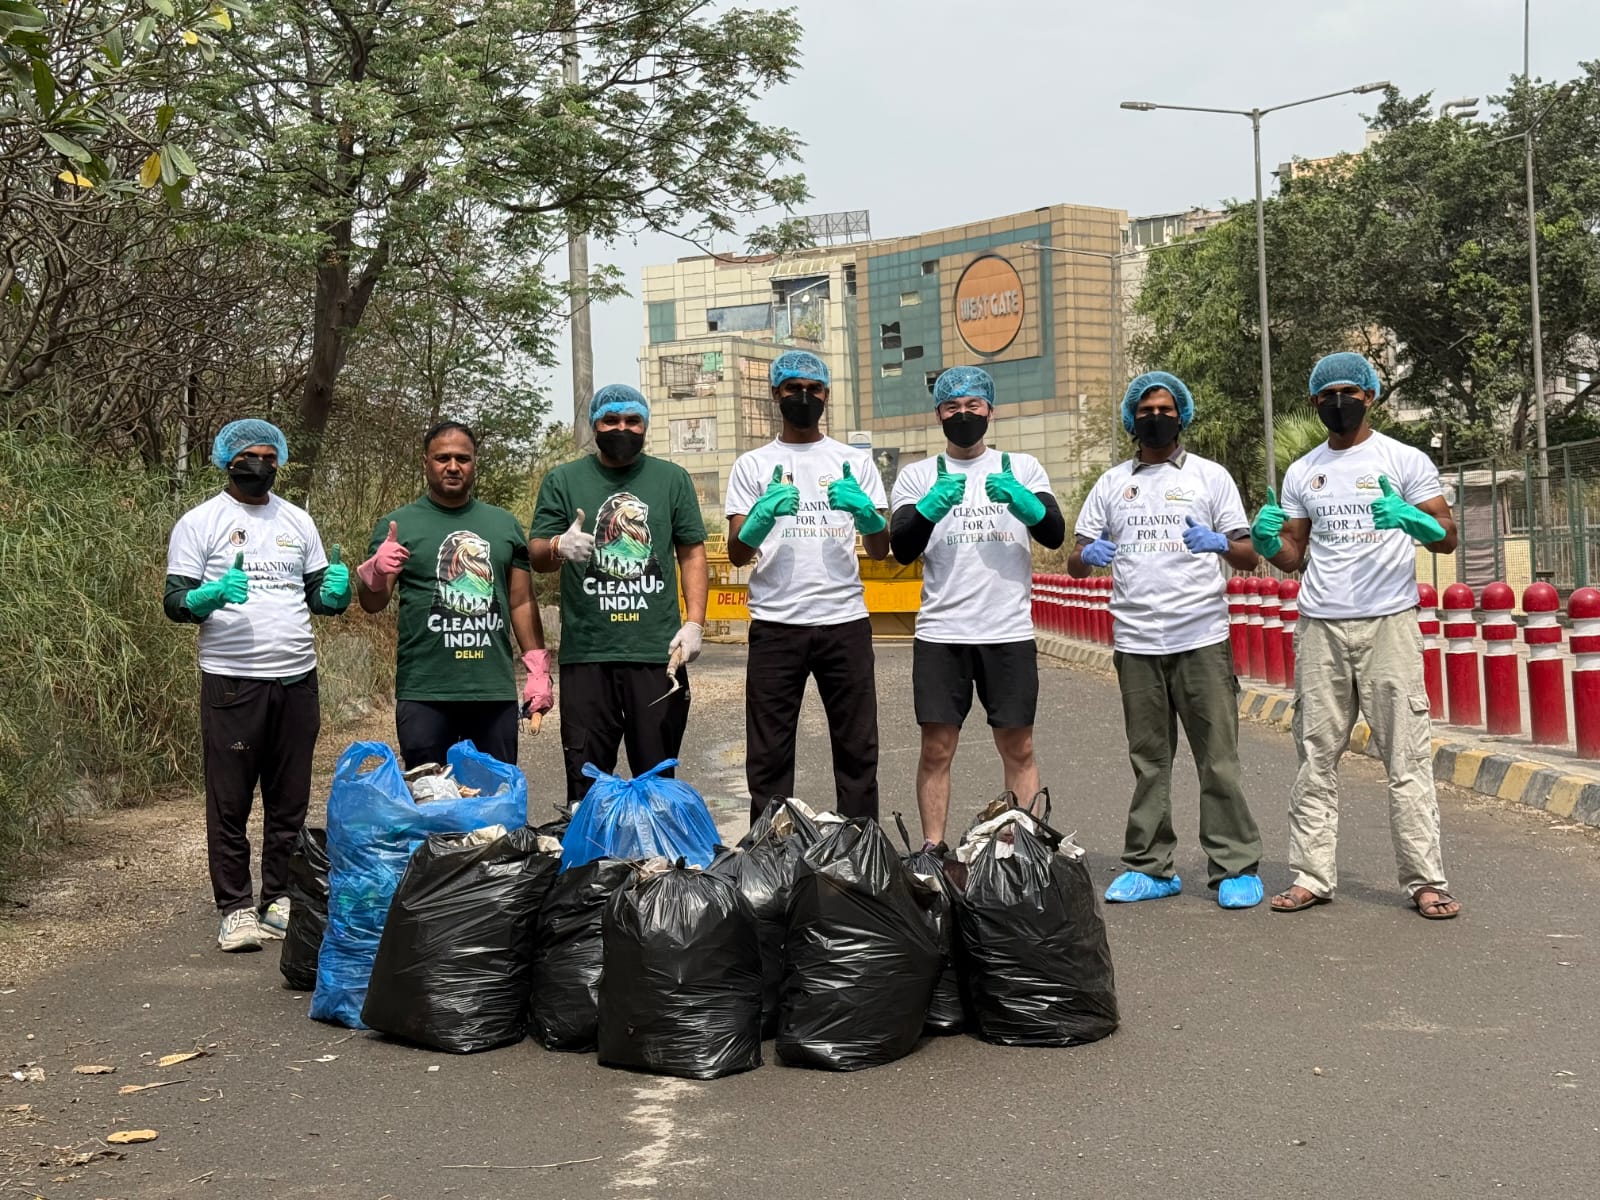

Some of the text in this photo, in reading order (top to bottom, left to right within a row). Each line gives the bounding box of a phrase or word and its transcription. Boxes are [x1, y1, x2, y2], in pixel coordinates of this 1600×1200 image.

[953, 504, 1004, 518] CLEANING
[796, 514, 828, 525] FOR A
[963, 519, 995, 531] FOR A
[1127, 514, 1181, 526] CLEANING
[1327, 519, 1363, 531] FOR A
[819, 527, 848, 538] INDIA
[947, 530, 1015, 546] BETTER INDIA
[1137, 529, 1169, 540] FOR A
[599, 595, 649, 611] INDIA
[610, 612, 640, 622] DELHI
[444, 632, 492, 648] INDIA
[455, 650, 484, 659] DELHI
